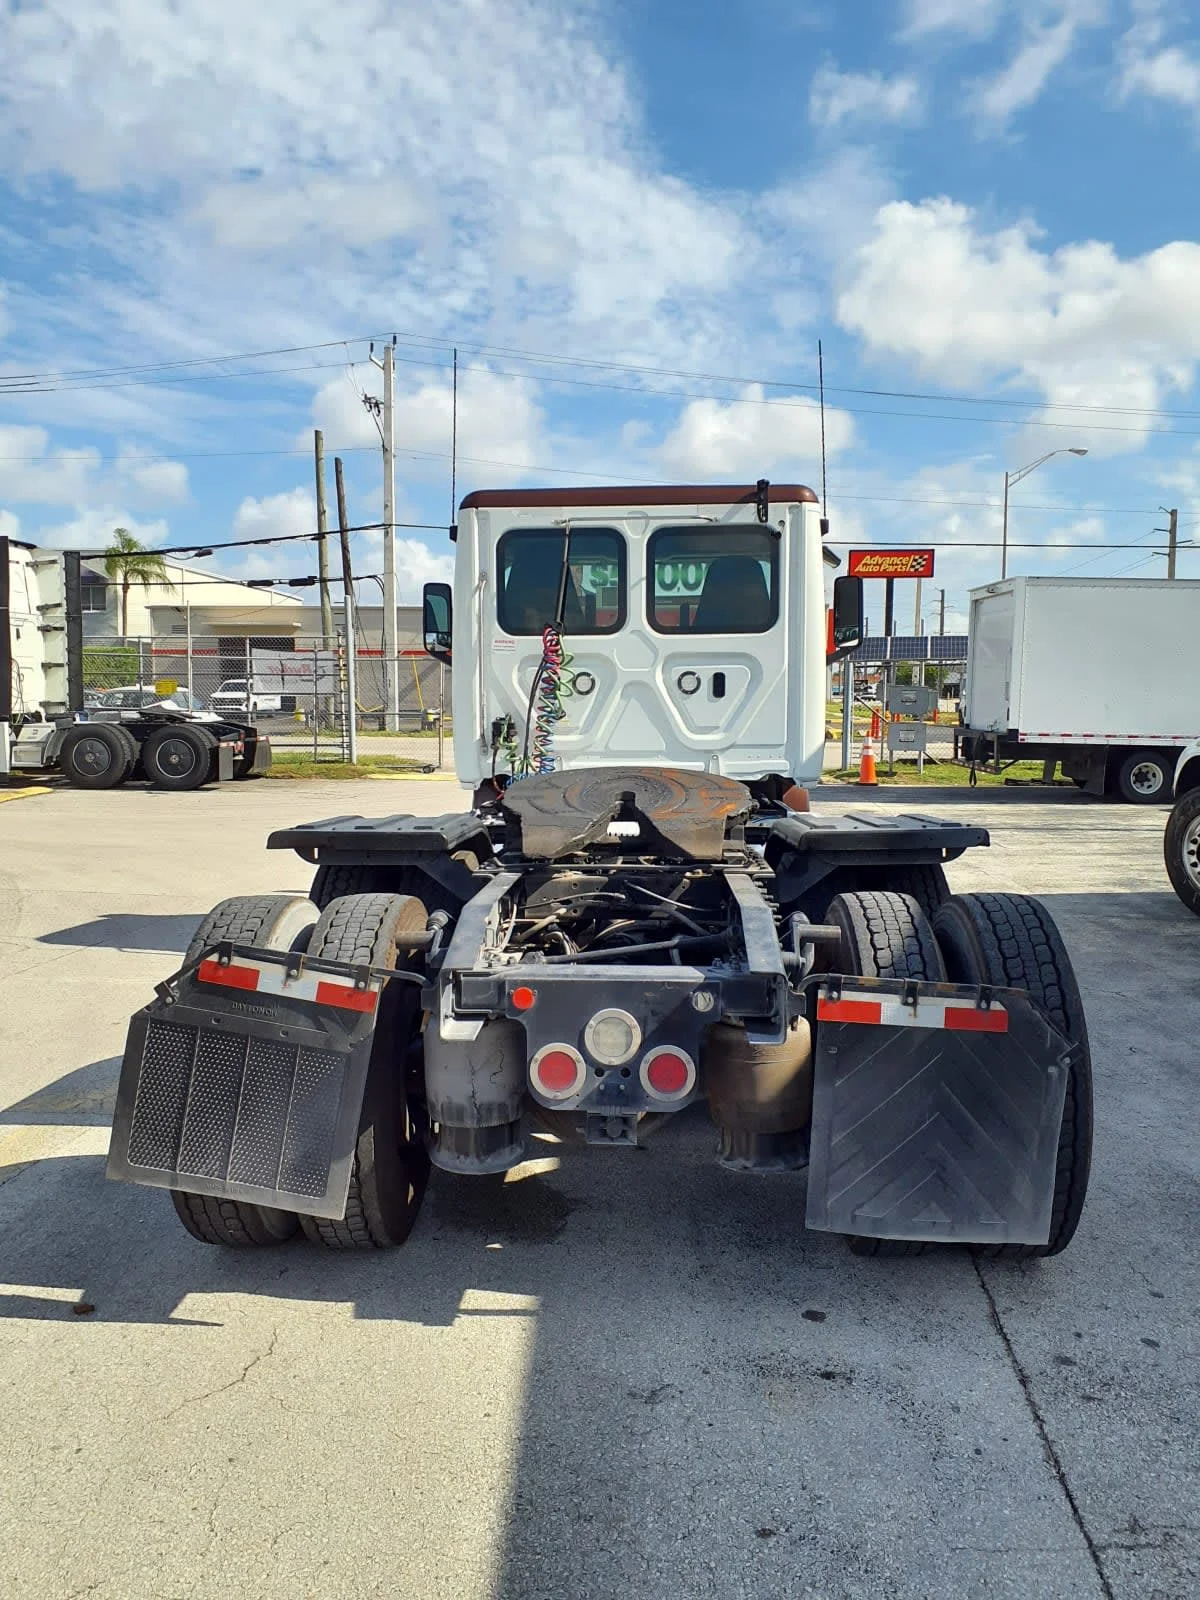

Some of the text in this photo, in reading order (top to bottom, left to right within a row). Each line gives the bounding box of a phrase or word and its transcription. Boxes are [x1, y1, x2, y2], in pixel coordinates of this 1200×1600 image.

[861, 555, 910, 565] Advance
[854, 564, 907, 572] Auto Parts
